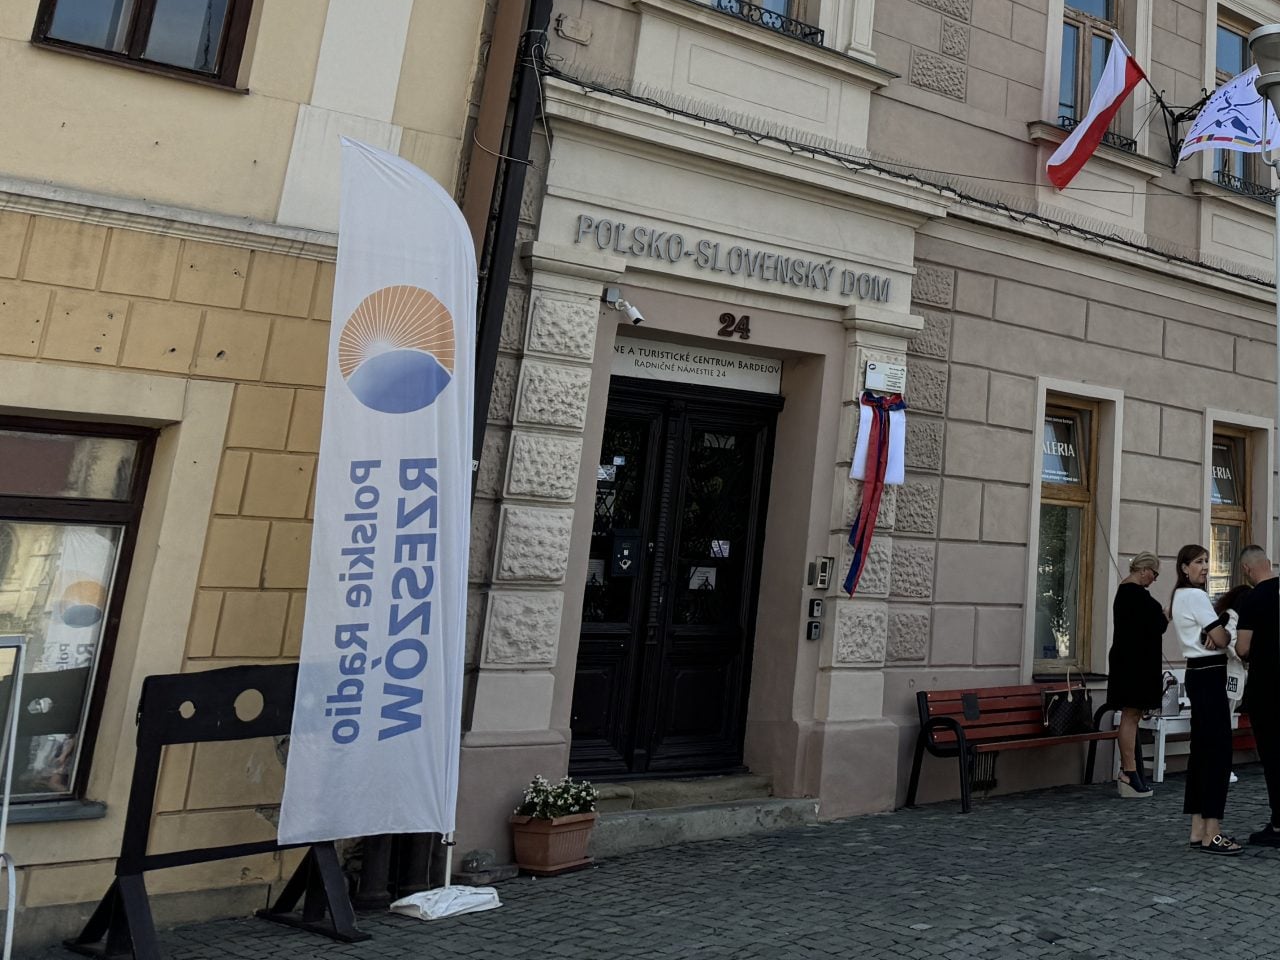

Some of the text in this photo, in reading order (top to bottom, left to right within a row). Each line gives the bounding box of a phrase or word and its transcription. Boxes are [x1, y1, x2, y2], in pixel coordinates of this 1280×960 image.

[840, 268, 892, 304] DOM
[717, 312, 751, 340] 24
[627, 346, 635, 356] A
[638, 347, 690, 362] TURISTICKÉ
[692, 355, 735, 369] CENTRUM
[716, 369, 727, 378] 24
